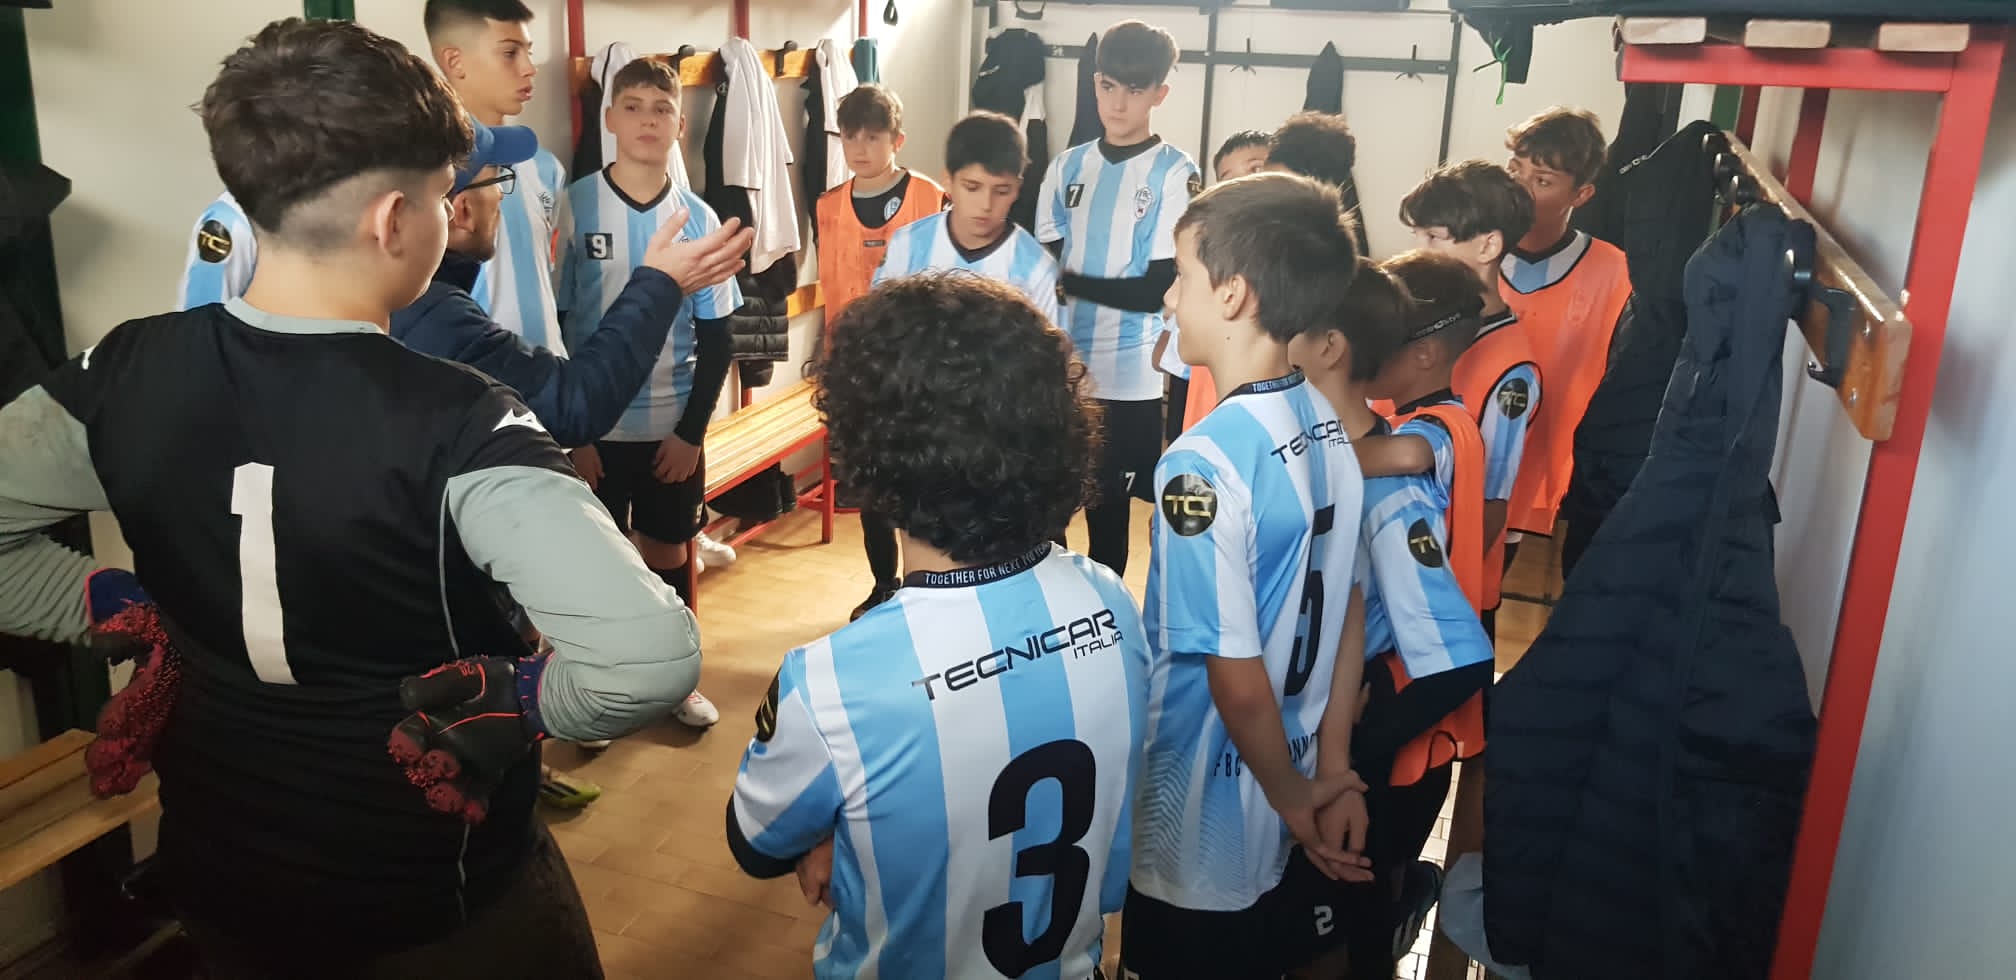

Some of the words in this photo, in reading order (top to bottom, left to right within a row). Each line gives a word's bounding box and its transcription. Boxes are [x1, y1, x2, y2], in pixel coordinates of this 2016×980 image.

[1069, 185, 1080, 208] 7
[592, 234, 607, 258] 9
[1125, 471, 1137, 492] 7
[230, 461, 299, 685] 1
[925, 570, 975, 585] TOGETHER
[978, 568, 997, 581] FOR
[999, 557, 1021, 576] NEXT
[1283, 503, 1335, 697] 5
[911, 608, 1118, 701] TECNICAR
[1073, 630, 1124, 660] ITALIA
[981, 738, 1096, 980] 3
[1313, 905, 1335, 936] 2
